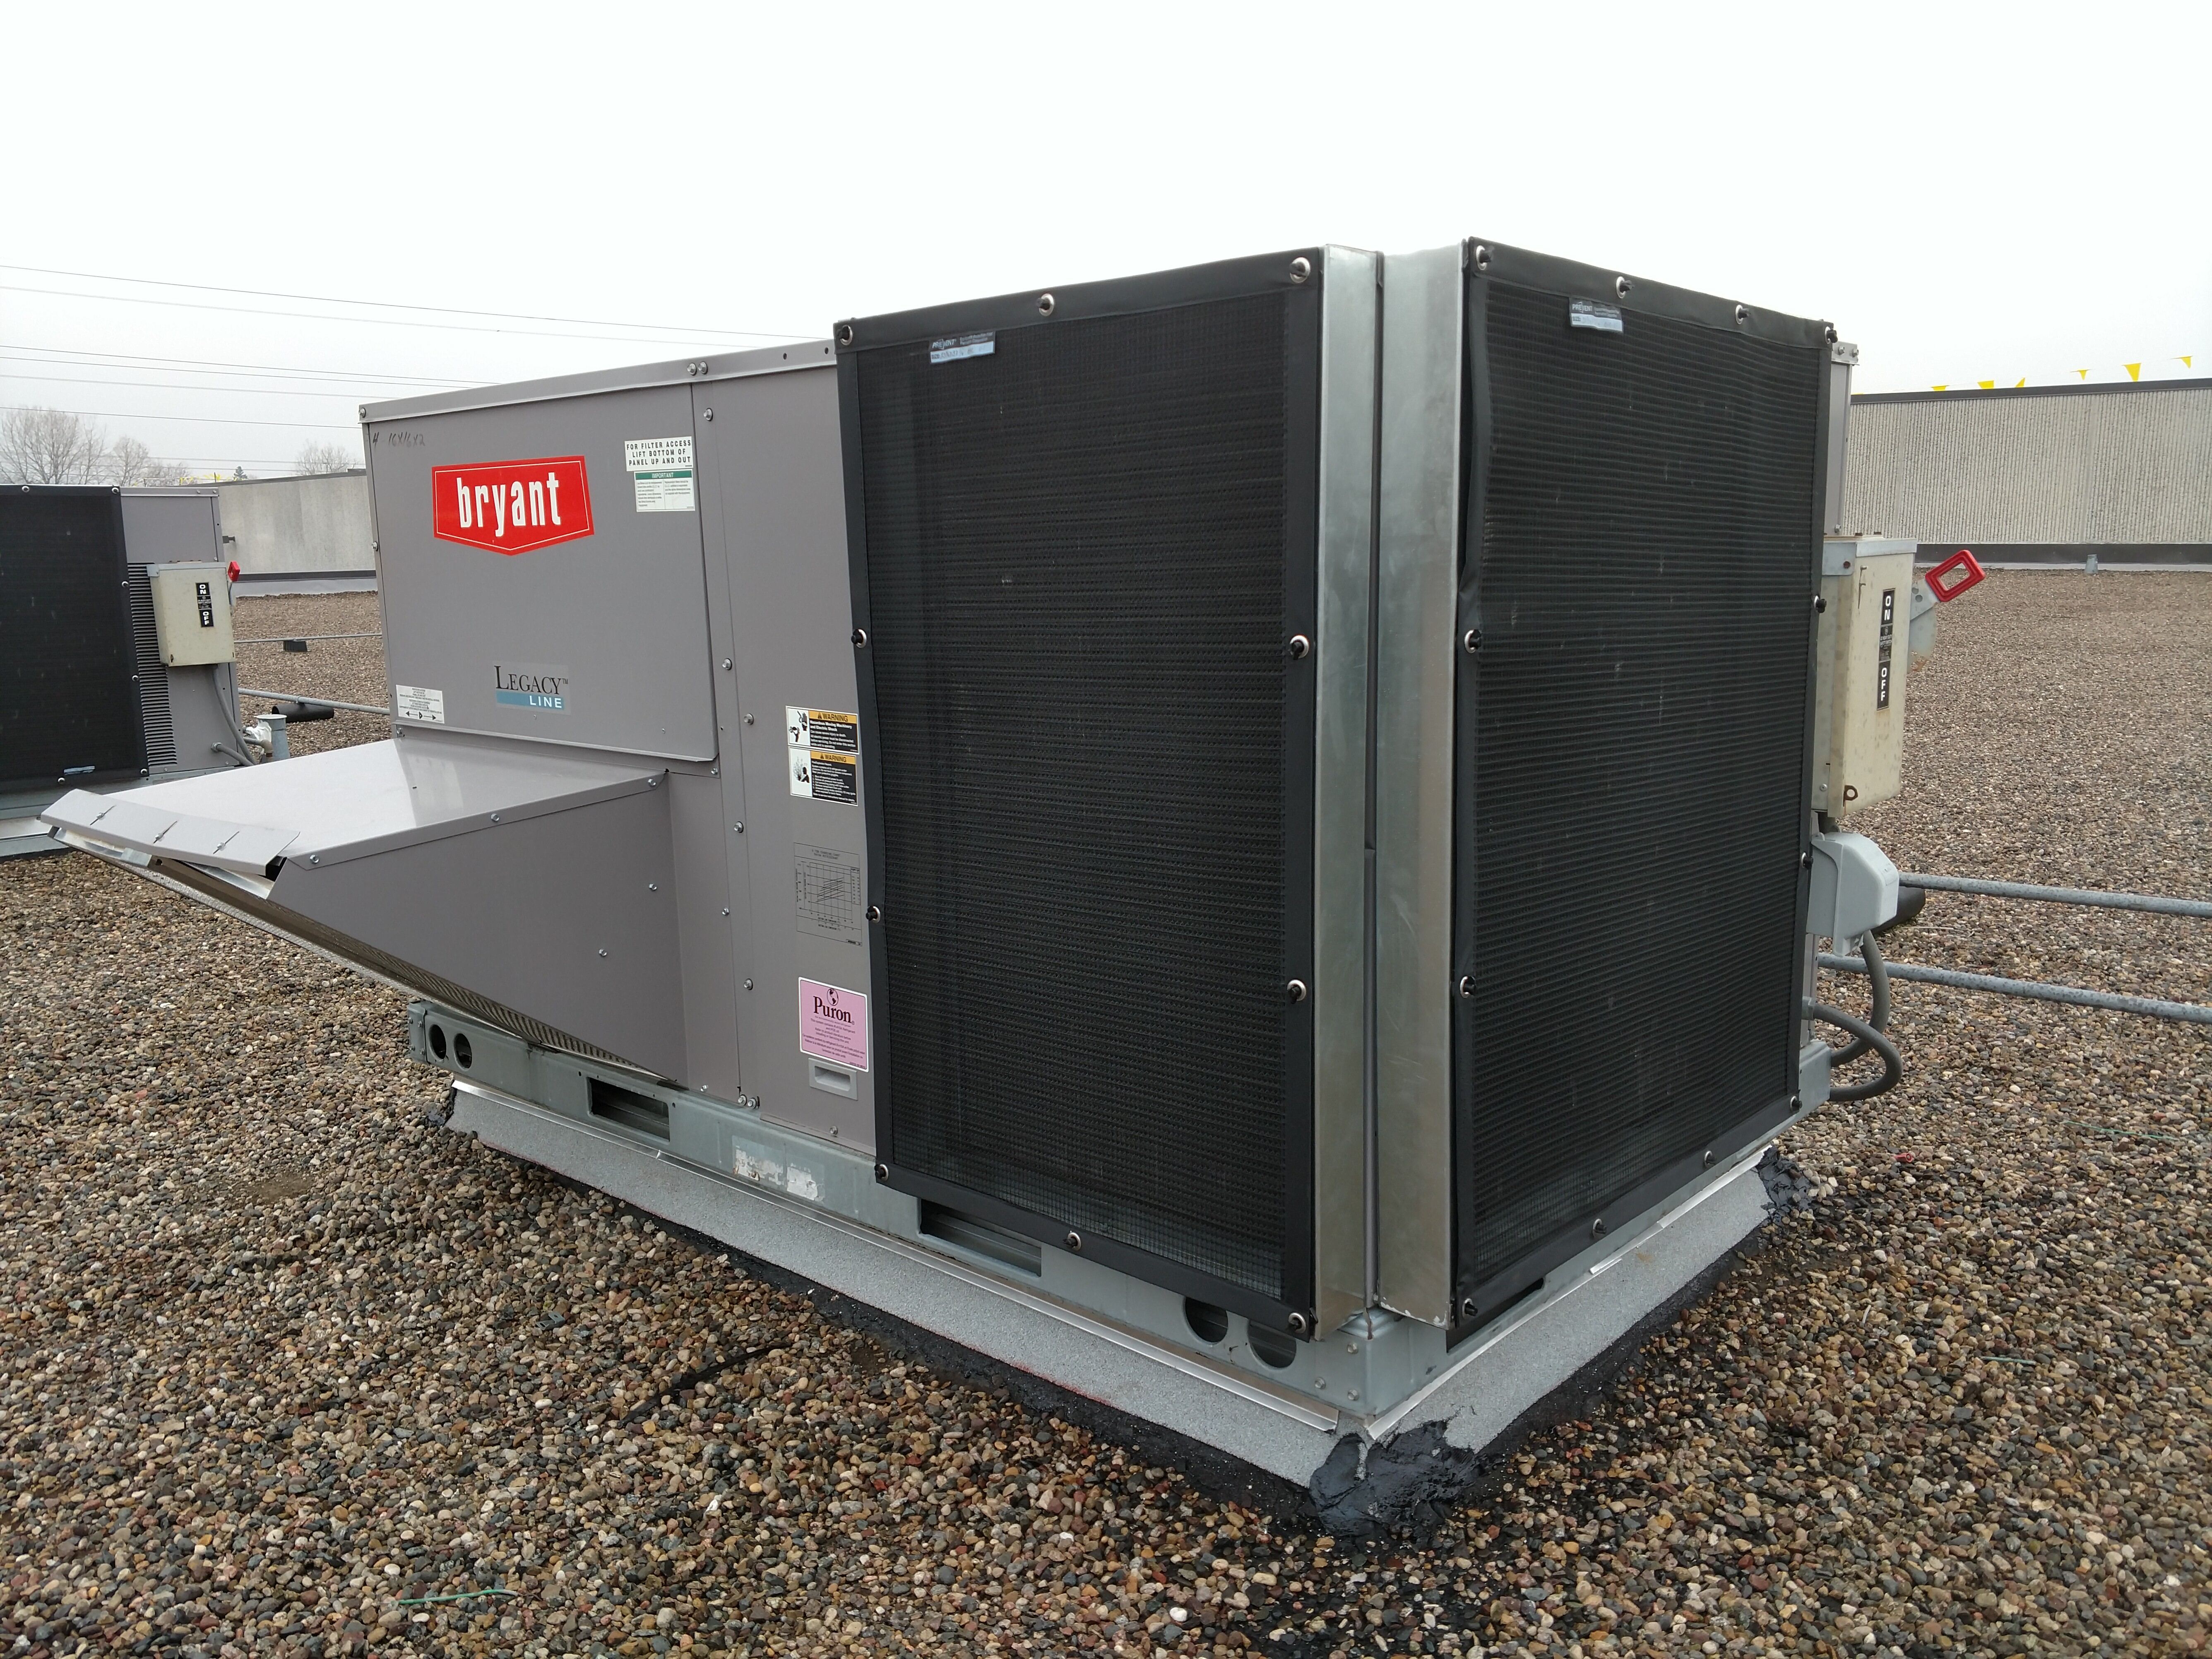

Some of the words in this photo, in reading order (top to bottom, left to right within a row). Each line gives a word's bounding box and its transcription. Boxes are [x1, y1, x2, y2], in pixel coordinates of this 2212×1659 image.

[457, 472, 561, 537] bryant
[200, 584, 207, 594] ON
[1884, 595, 1891, 621] ON
[529, 695, 562, 708] LINE
[822, 713, 848, 722] WARNING
[813, 996, 852, 1023] Puron
